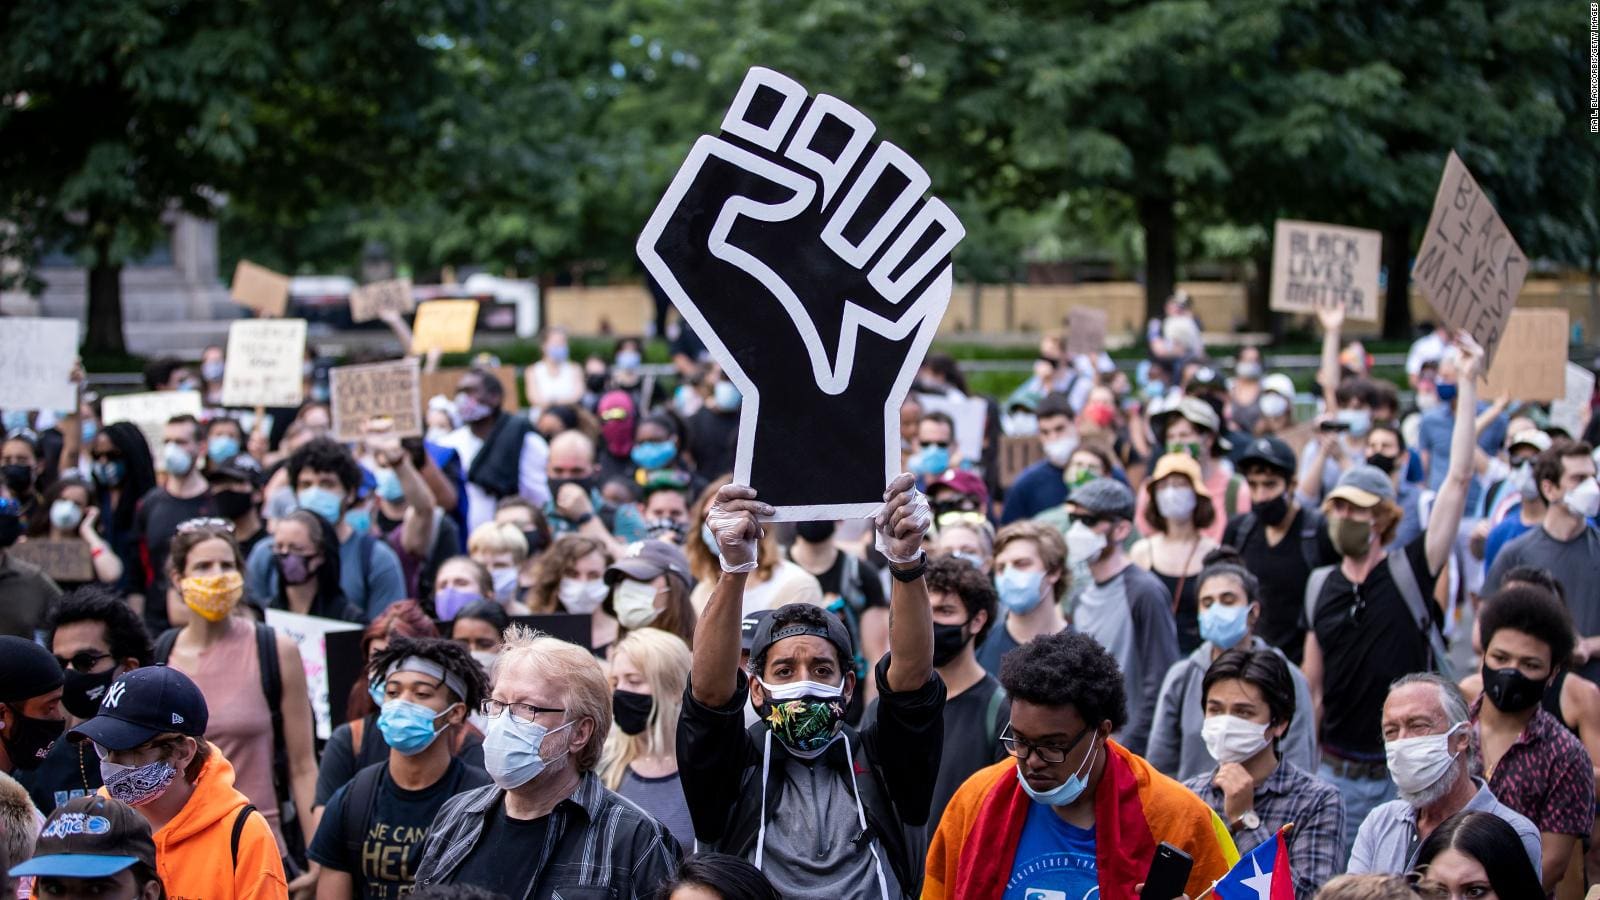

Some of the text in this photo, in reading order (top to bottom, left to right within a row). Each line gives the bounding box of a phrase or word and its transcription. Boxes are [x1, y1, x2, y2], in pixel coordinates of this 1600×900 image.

[1289, 229, 1360, 263] BLACK
[1454, 171, 1520, 291] BLACK
[1288, 254, 1354, 288] LIVES
[1437, 206, 1510, 319] LIVES
[1285, 281, 1365, 313] MATTER
[1417, 245, 1499, 370] MATTER
[102, 681, 126, 708] NY
[361, 841, 416, 882] HEL
[1076, 858, 1096, 870] TRA
